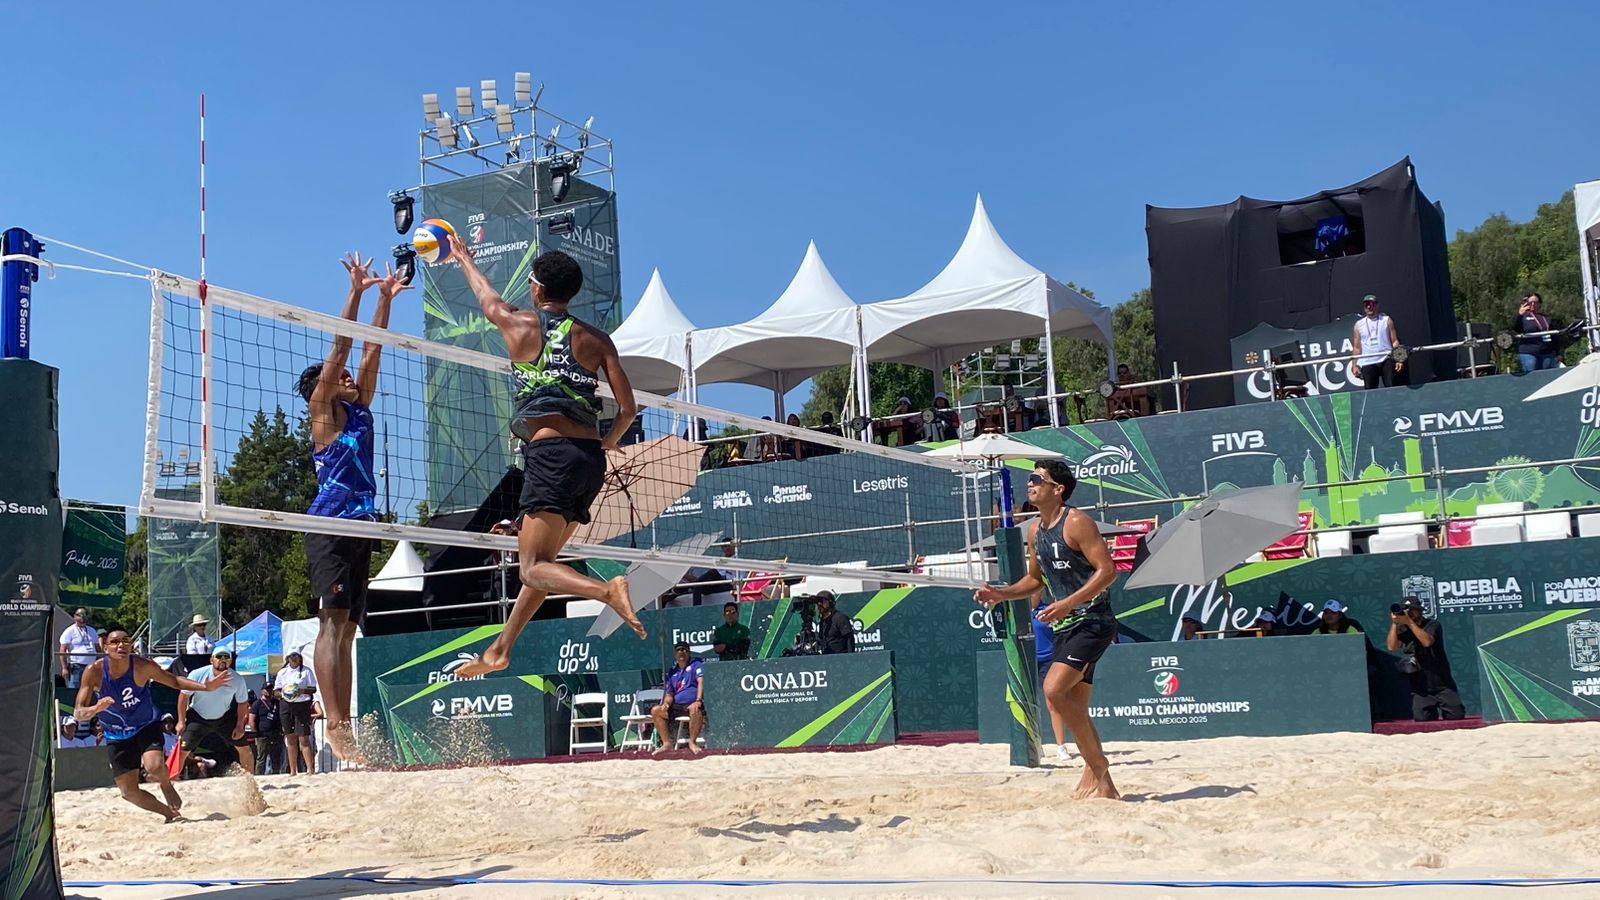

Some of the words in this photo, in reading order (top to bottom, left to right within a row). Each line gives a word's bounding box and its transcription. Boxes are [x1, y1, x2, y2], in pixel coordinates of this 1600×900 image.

[468, 213, 485, 223] FIVB
[20, 309, 28, 348] Senoh
[546, 330, 563, 349] 2
[544, 353, 570, 365] MEX
[1419, 406, 1504, 431] FMVB
[1212, 430, 1264, 452] FIVB
[773, 484, 807, 496] Pensar
[853, 474, 908, 493] Lesotris
[713, 496, 753, 509] PUEBLA
[774, 491, 813, 504] Grande
[8, 502, 48, 515] Senoh
[1052, 543, 1059, 559] 1
[65, 549, 95, 567] Puebla
[97, 557, 119, 569] 2025
[1437, 577, 1521, 598] PUEBLA
[1544, 582, 1563, 590] POR
[1563, 577, 1600, 589] AMO
[1439, 597, 1477, 606] Gobierno
[1493, 594, 1522, 602] Estado
[1545, 588, 1600, 604] PUEB
[560, 639, 590, 661] dry
[558, 658, 579, 674] up
[1151, 656, 1179, 667] FIVB
[740, 670, 828, 692] CONADE
[122, 687, 133, 701] 2
[615, 694, 631, 703] U21
[1158, 696, 1196, 704] VOLLEYBALL
[122, 697, 140, 708] THA
[451, 694, 513, 714] FMVB
[1088, 706, 1110, 717] U21
[1113, 705, 1153, 716] WORLD
[1156, 701, 1250, 716] CHAMPIONSHIPS
[1159, 717, 1188, 725] MEXICO
[1189, 716, 1208, 724] 2025
